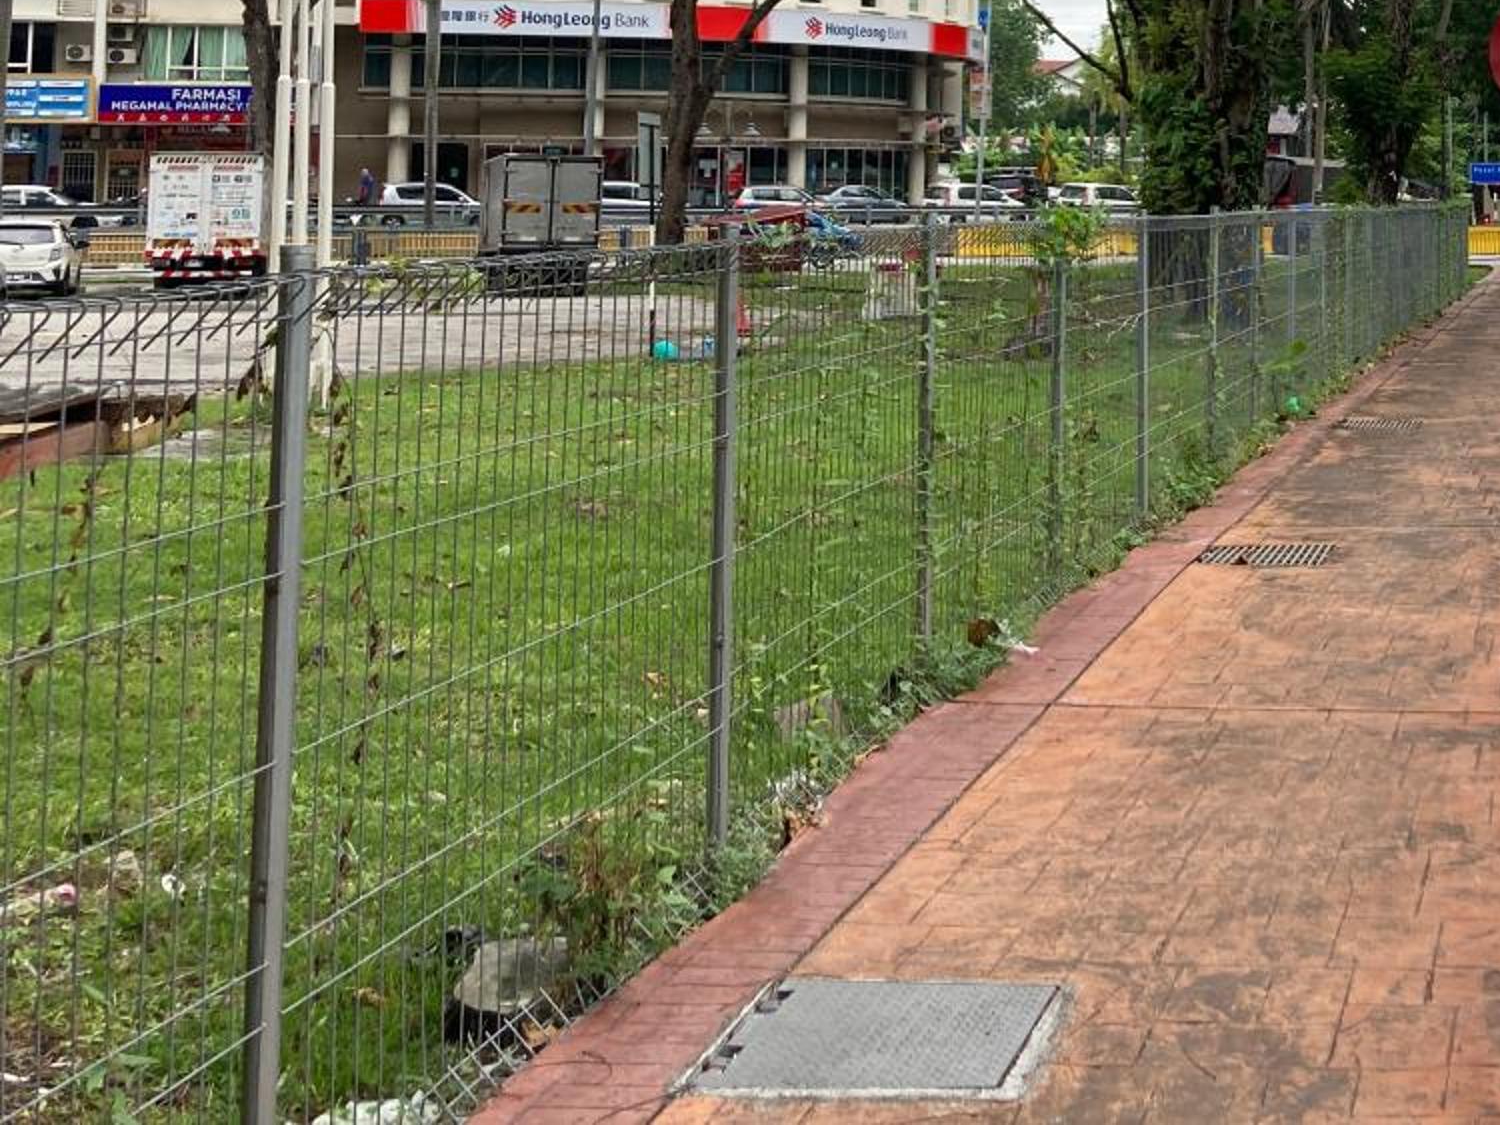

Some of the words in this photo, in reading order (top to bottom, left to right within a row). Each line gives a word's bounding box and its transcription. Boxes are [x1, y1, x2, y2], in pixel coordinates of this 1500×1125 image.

[520, 10, 611, 30] HongLeog
[615, 13, 650, 28] Bank
[825, 21, 887, 42] HongLeong
[888, 26, 908, 40] Bank
[171, 88, 241, 101] FARMASI
[175, 101, 242, 112] PHARMACY
